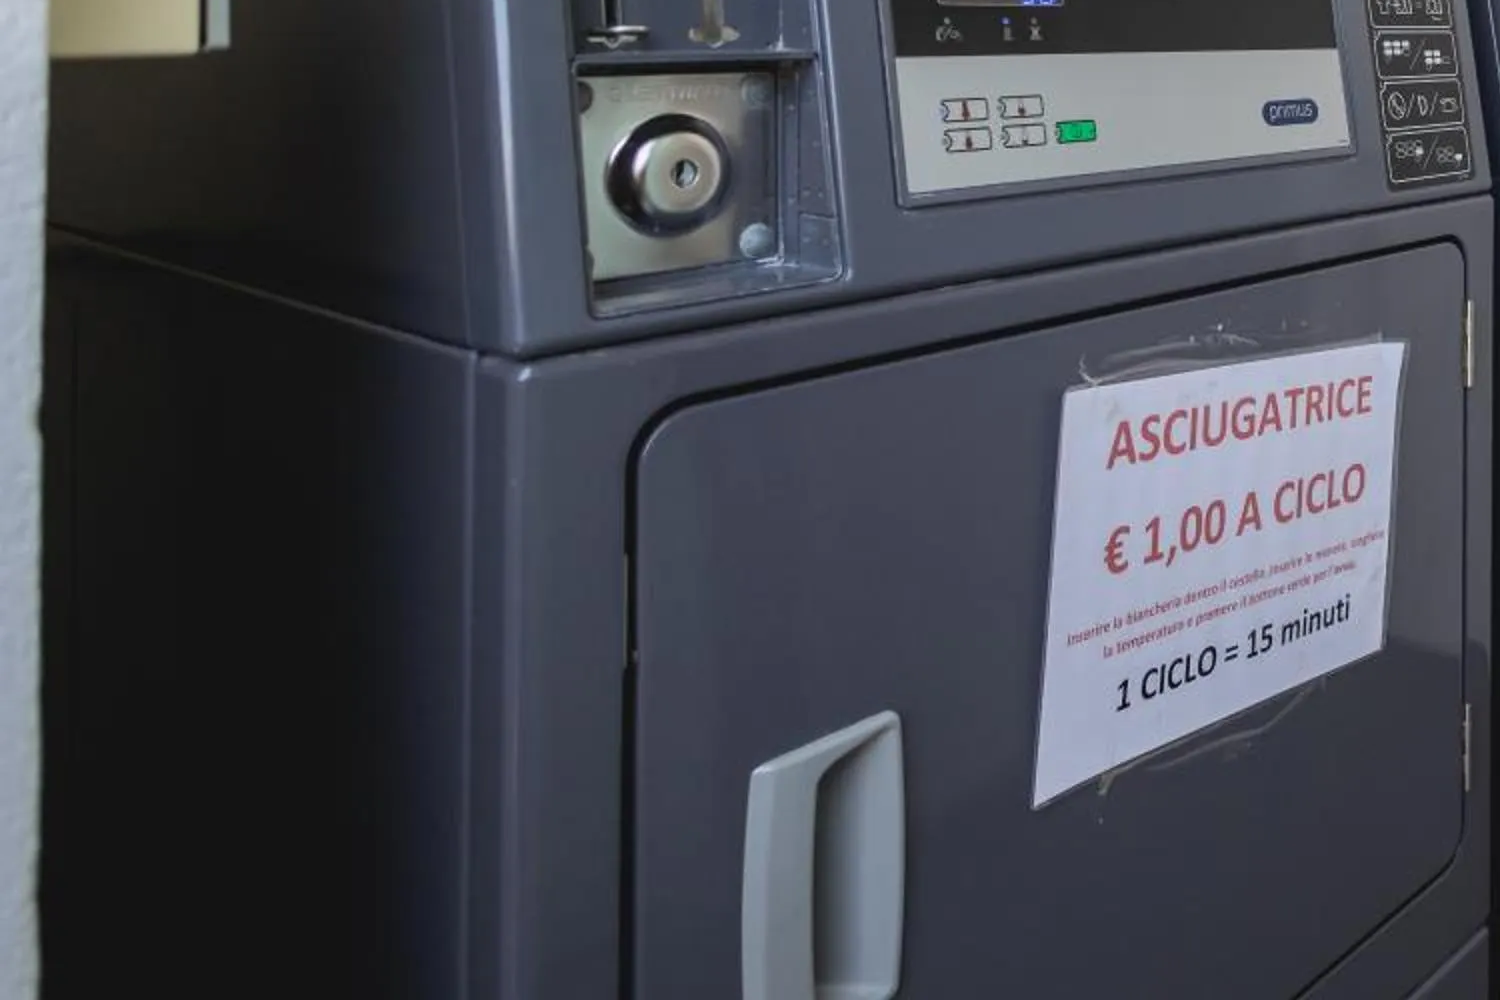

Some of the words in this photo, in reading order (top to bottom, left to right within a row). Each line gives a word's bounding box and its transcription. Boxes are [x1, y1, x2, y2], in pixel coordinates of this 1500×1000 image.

[1106, 375, 1374, 470] ASCIUGATRICE
[1104, 525, 1131, 574] €
[1143, 499, 1227, 567] 1,00
[1236, 491, 1263, 537] A
[1273, 463, 1366, 524] CICLO
[1113, 615, 1123, 630] la
[1115, 678, 1131, 712] 1
[1140, 645, 1218, 701] CICLO
[1224, 644, 1240, 663] =
[1247, 623, 1273, 660] 15
[1279, 593, 1352, 646] minuti
[1116, 620, 1184, 654] temperatura
